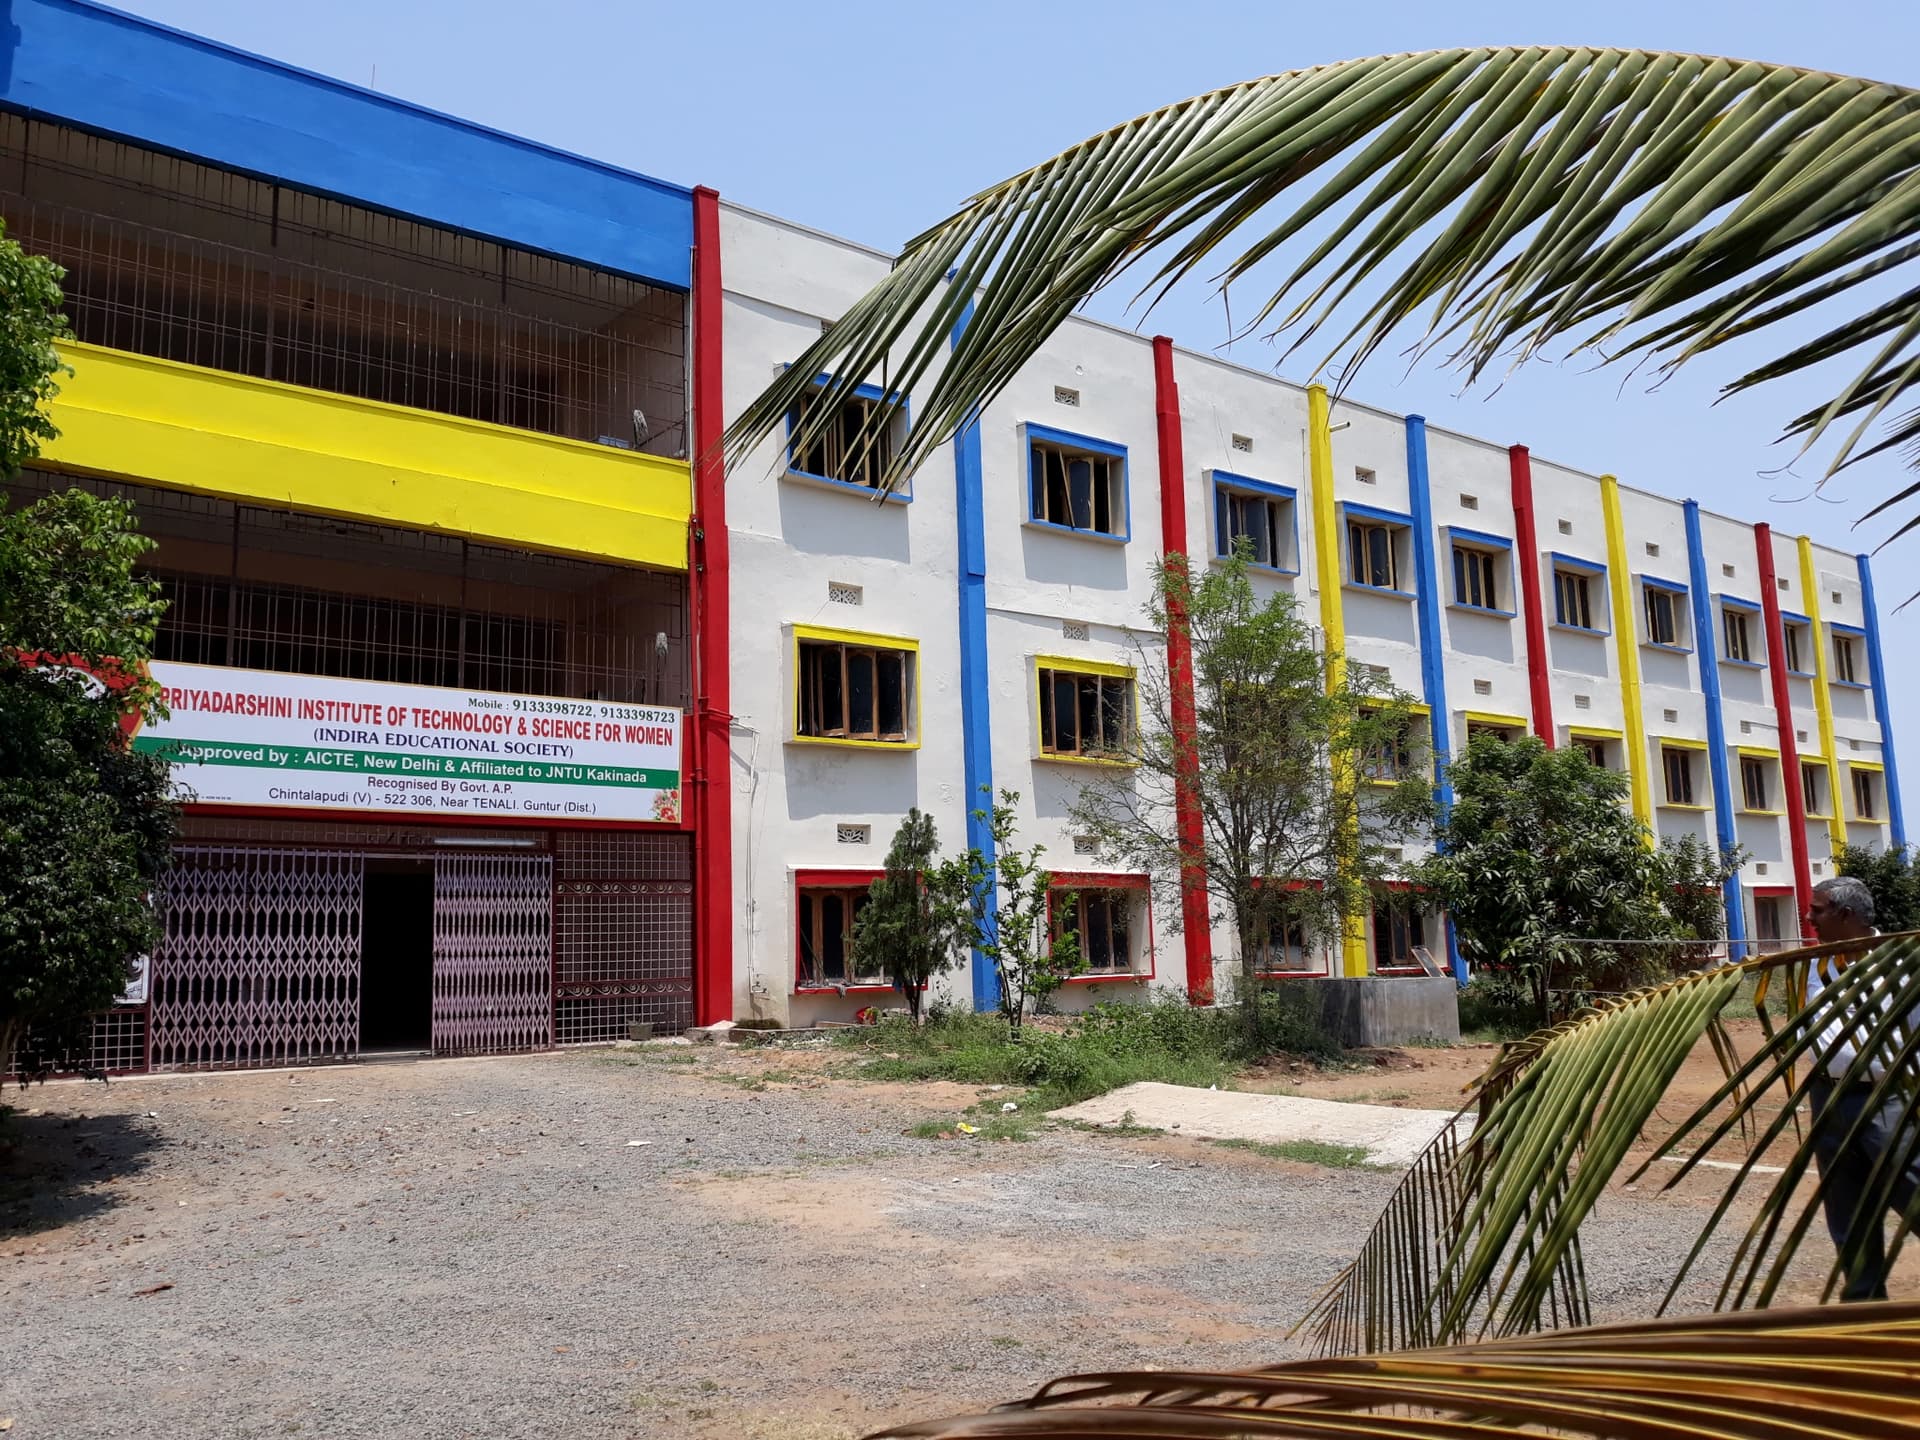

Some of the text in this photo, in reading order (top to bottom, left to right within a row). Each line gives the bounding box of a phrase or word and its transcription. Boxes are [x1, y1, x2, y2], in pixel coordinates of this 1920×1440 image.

[160, 688, 673, 746] PRIYADARSHINI INSTITUTE OF TECHNOLOGY & SCIENCE FOR WOMEN
[468, 698, 505, 709] Mobile
[601, 706, 675, 723] 9133398723
[313, 728, 574, 759] (INDIRA EDUCATIONAL SOCIETY)
[179, 745, 263, 762] Approved
[269, 749, 288, 765] by
[304, 752, 358, 768] AICTE,
[364, 755, 396, 769] New
[402, 757, 440, 771] Delhi
[445, 761, 455, 773] &
[460, 760, 525, 776] Affiliated
[529, 765, 541, 777] to
[546, 764, 583, 779] JNTU
[587, 768, 646, 782] Kakinada
[368, 777, 512, 794] Recognised By Govt. A.P.
[269, 788, 348, 804] Chintalapudi
[353, 792, 371, 806] (V)
[384, 794, 406, 804] 522
[411, 795, 436, 807] 306,
[441, 797, 468, 808] Near
[523, 800, 560, 812] Guntur
[564, 801, 596, 815] (Dist.)
